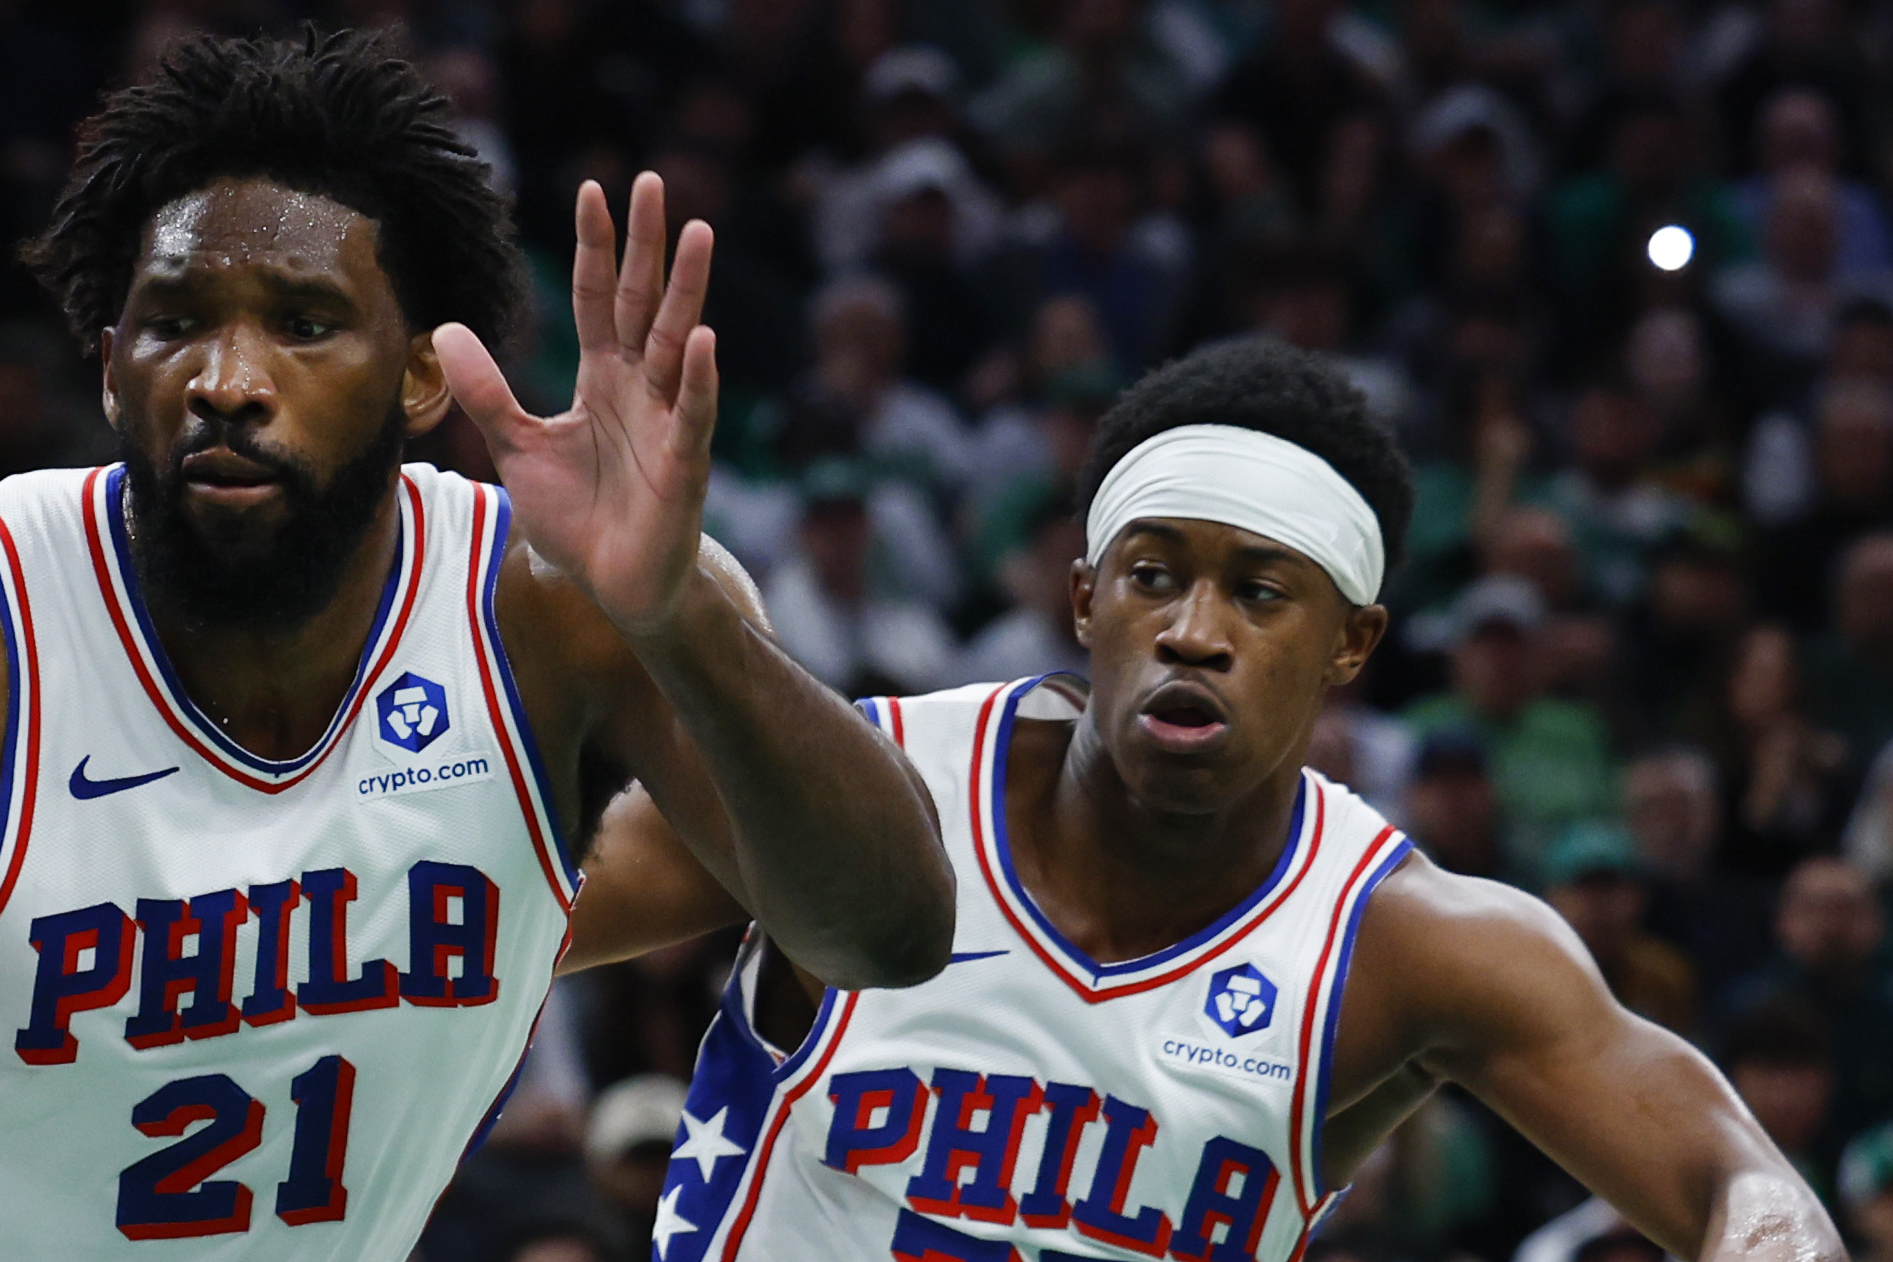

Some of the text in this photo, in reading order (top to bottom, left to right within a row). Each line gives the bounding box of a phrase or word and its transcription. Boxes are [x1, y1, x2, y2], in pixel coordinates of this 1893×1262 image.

[358, 758, 489, 795] crypto.com
[14, 859, 500, 1066] PHILA
[1163, 1040, 1292, 1081] crypto.com
[115, 1054, 357, 1242] 21
